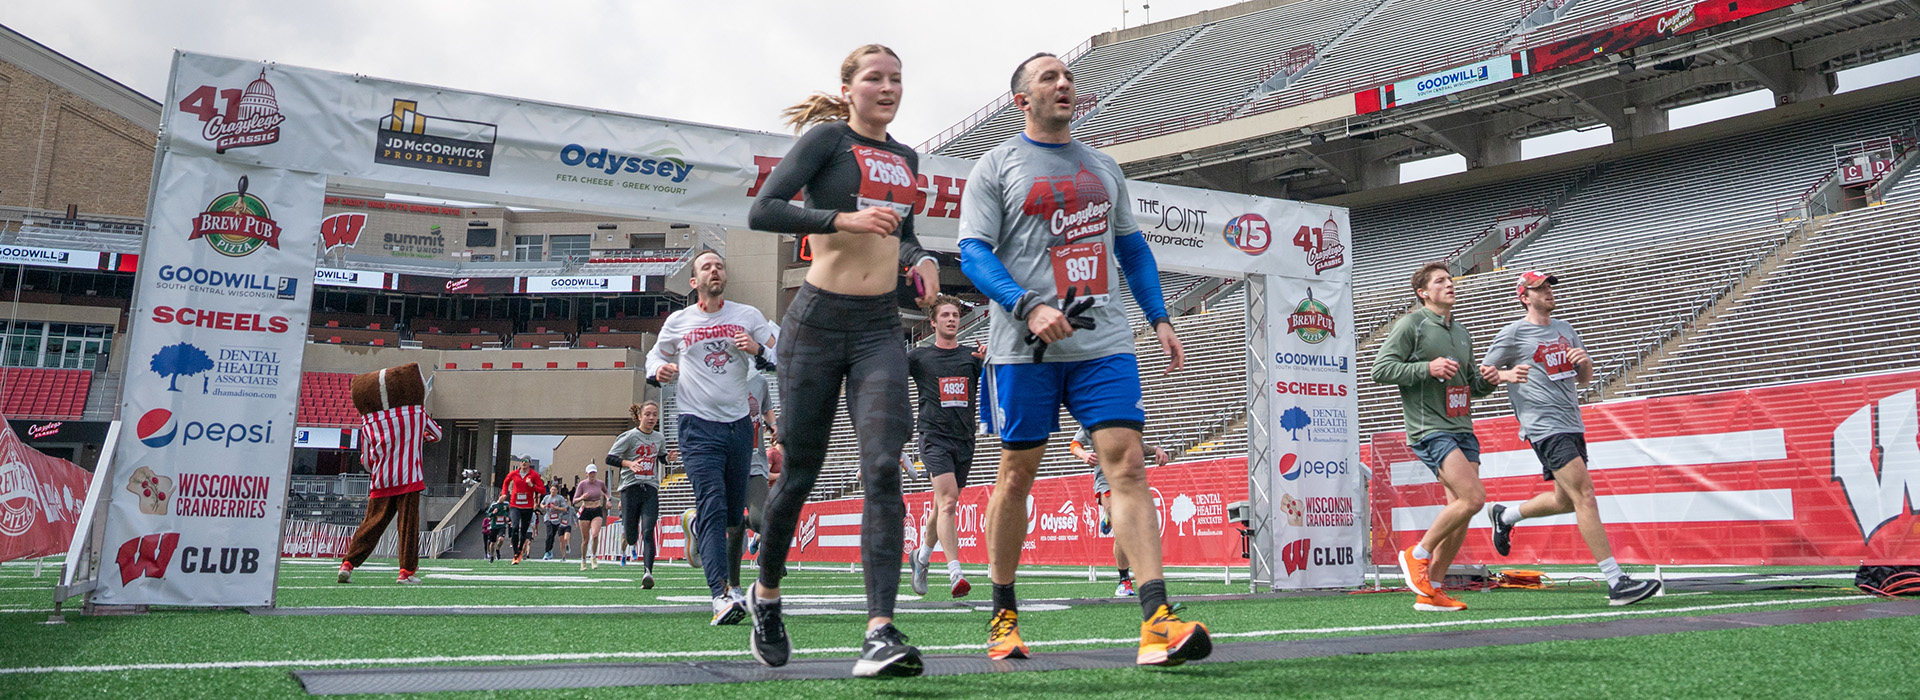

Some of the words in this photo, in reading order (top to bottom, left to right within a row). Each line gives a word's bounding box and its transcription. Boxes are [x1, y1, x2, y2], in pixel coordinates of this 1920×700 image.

[1417, 69, 1477, 91] GOODWILL
[179, 85, 243, 122] 41
[203, 114, 285, 140] Crazylegs
[220, 132, 275, 147] CLASSIC
[385, 137, 403, 149] JD
[384, 149, 483, 168] PROPERTIES
[559, 143, 695, 183] Odyssey
[1876, 161, 1885, 171] D
[865, 158, 911, 188] 2639
[1848, 166, 1857, 177] C
[556, 173, 578, 183] FETA
[580, 176, 614, 187] CHEESE
[622, 181, 650, 191] GREEK
[652, 184, 688, 195] YOGURT
[1022, 180, 1078, 220] 41
[1138, 198, 1158, 214] THE
[200, 214, 243, 231] BREW
[243, 215, 273, 238] PUB
[1051, 201, 1112, 236] Crazylegs
[1155, 205, 1207, 234] JOINT
[1066, 220, 1107, 240] CLASSIC
[1240, 219, 1267, 248] 15
[1509, 227, 1516, 236] B
[217, 240, 252, 253] PIZZA
[384, 232, 445, 247] summit
[1140, 230, 1204, 248] hiropractic
[1293, 225, 1323, 253] 41
[0, 247, 57, 259] OODWILL
[383, 244, 414, 252] CRDIT
[416, 246, 444, 254] UNION
[1066, 255, 1098, 282] 897
[1317, 257, 1342, 270] CLASSIC
[159, 265, 276, 291] GOODWILL
[315, 270, 348, 280] DWILL
[551, 278, 600, 287] GOODWILL
[156, 282, 187, 291] SOUTH
[189, 285, 225, 296] CENTRAL
[228, 290, 275, 299] WISCONSIN
[152, 305, 289, 333] SCHEELS
[1292, 314, 1317, 327] BREW
[1317, 314, 1333, 330] PUB
[1302, 332, 1323, 341] PIZZA
[219, 349, 281, 363] DENTAL
[1275, 352, 1338, 367] GOODWILL
[1545, 350, 1567, 367] 8677
[216, 362, 279, 376] HEALTH
[215, 375, 278, 386] ASSOCIATES
[943, 383, 966, 395] 4932
[1276, 381, 1348, 397] SCHEELS
[212, 388, 277, 399] dhamadison.com
[1312, 409, 1347, 418] DENTAL
[1312, 418, 1347, 427] HEALTH
[182, 420, 273, 447] pepsi
[636, 445, 651, 456] 41
[1304, 458, 1348, 479] pepsi
[178, 473, 270, 499] WISCONSIN
[1196, 493, 1222, 505] DENTAL
[1305, 497, 1353, 514] WISCONSIN
[176, 498, 267, 518] CRANBERRIES
[1197, 505, 1223, 516] HEALTH
[2, 508, 32, 529] PIZZA
[1040, 513, 1078, 533] Odyssey
[1306, 514, 1354, 527] CRANBERRIES
[115, 533, 180, 587] W
[181, 546, 260, 574] CLUB
[1282, 538, 1311, 577] W
[1313, 547, 1354, 566] CLUB
